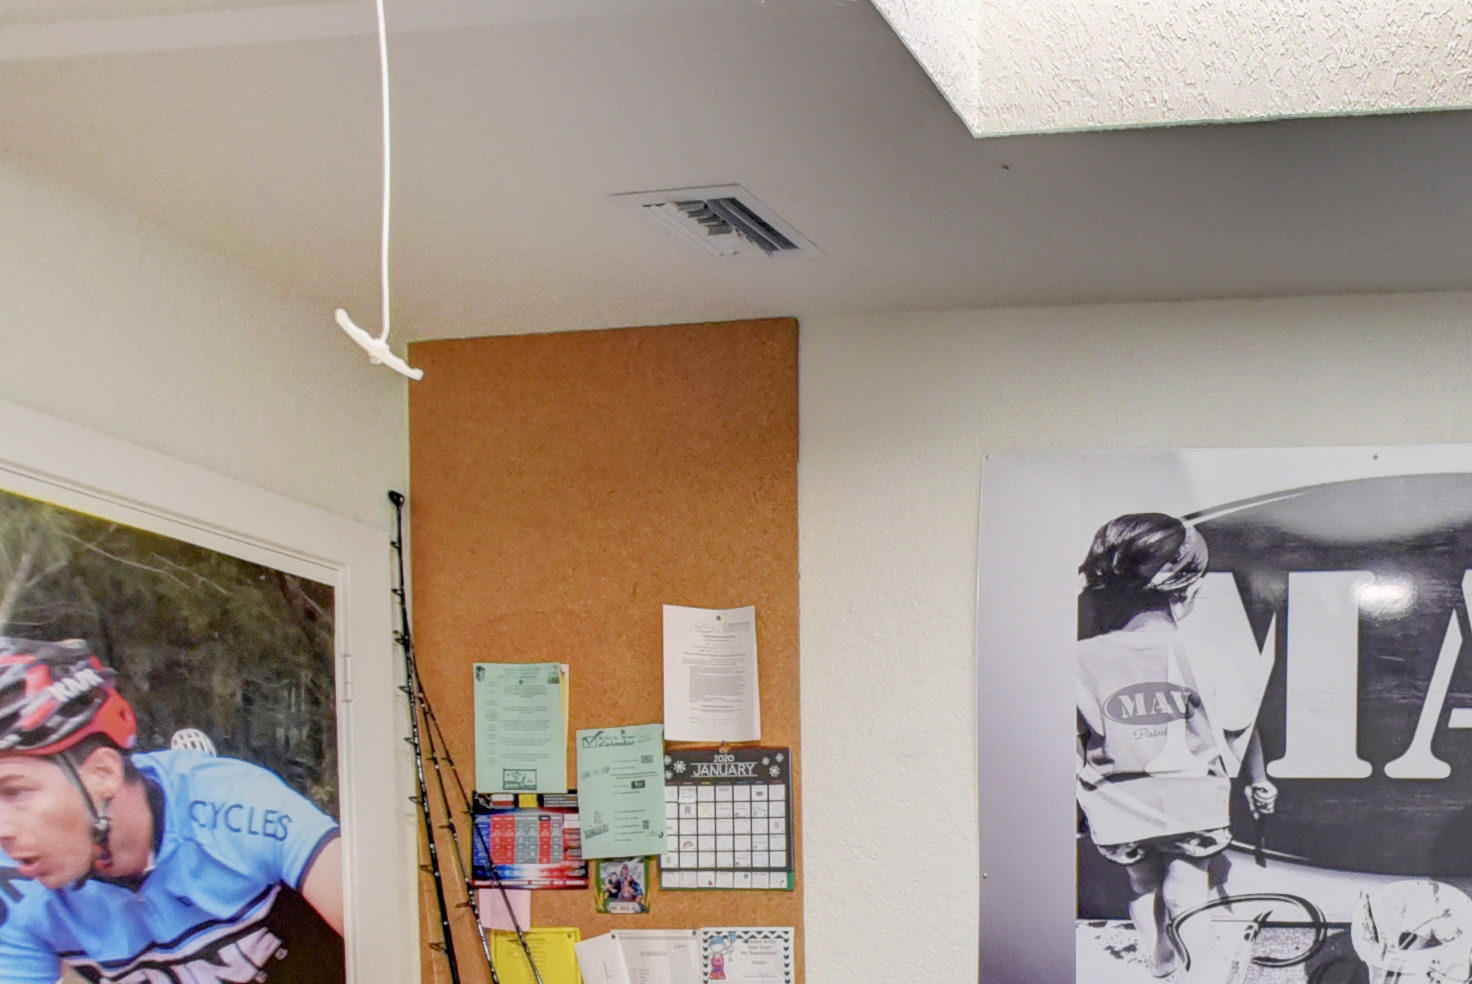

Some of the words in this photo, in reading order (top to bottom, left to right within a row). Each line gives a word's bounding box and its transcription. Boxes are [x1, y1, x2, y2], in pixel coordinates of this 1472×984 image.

[1118, 690, 1191, 719] MAV
[692, 762, 757, 777] JANUARY
[713, 754, 735, 763] 2020
[188, 800, 292, 842] CYCLES
